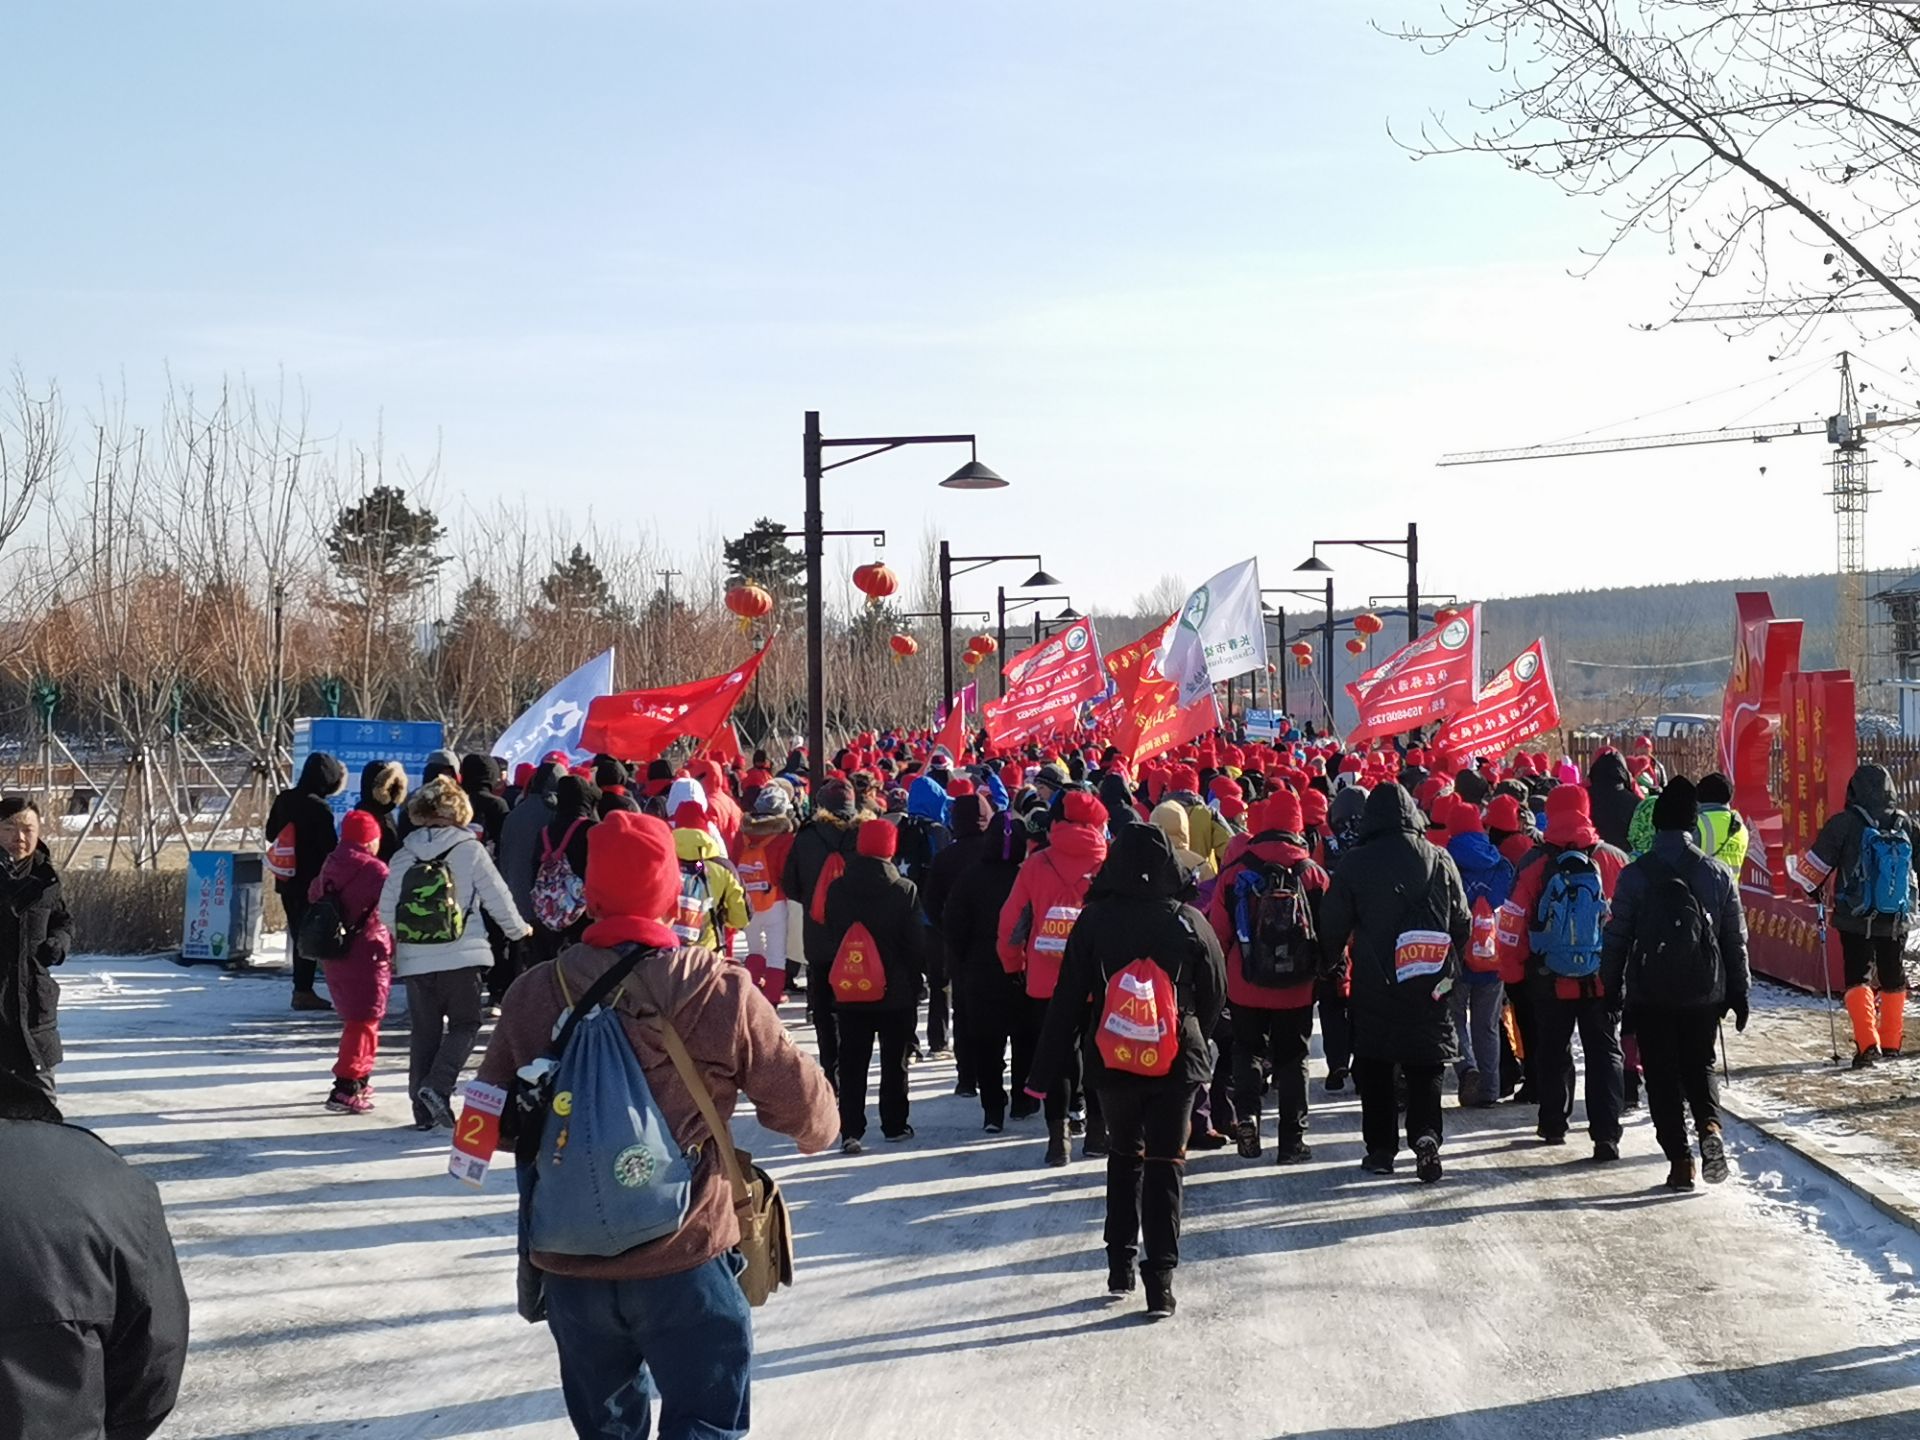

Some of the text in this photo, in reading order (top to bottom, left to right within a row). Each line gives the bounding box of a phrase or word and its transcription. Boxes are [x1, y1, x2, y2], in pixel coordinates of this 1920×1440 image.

[1796, 698, 1809, 853] 弘扬民族
[1399, 944, 1446, 963] A0775
